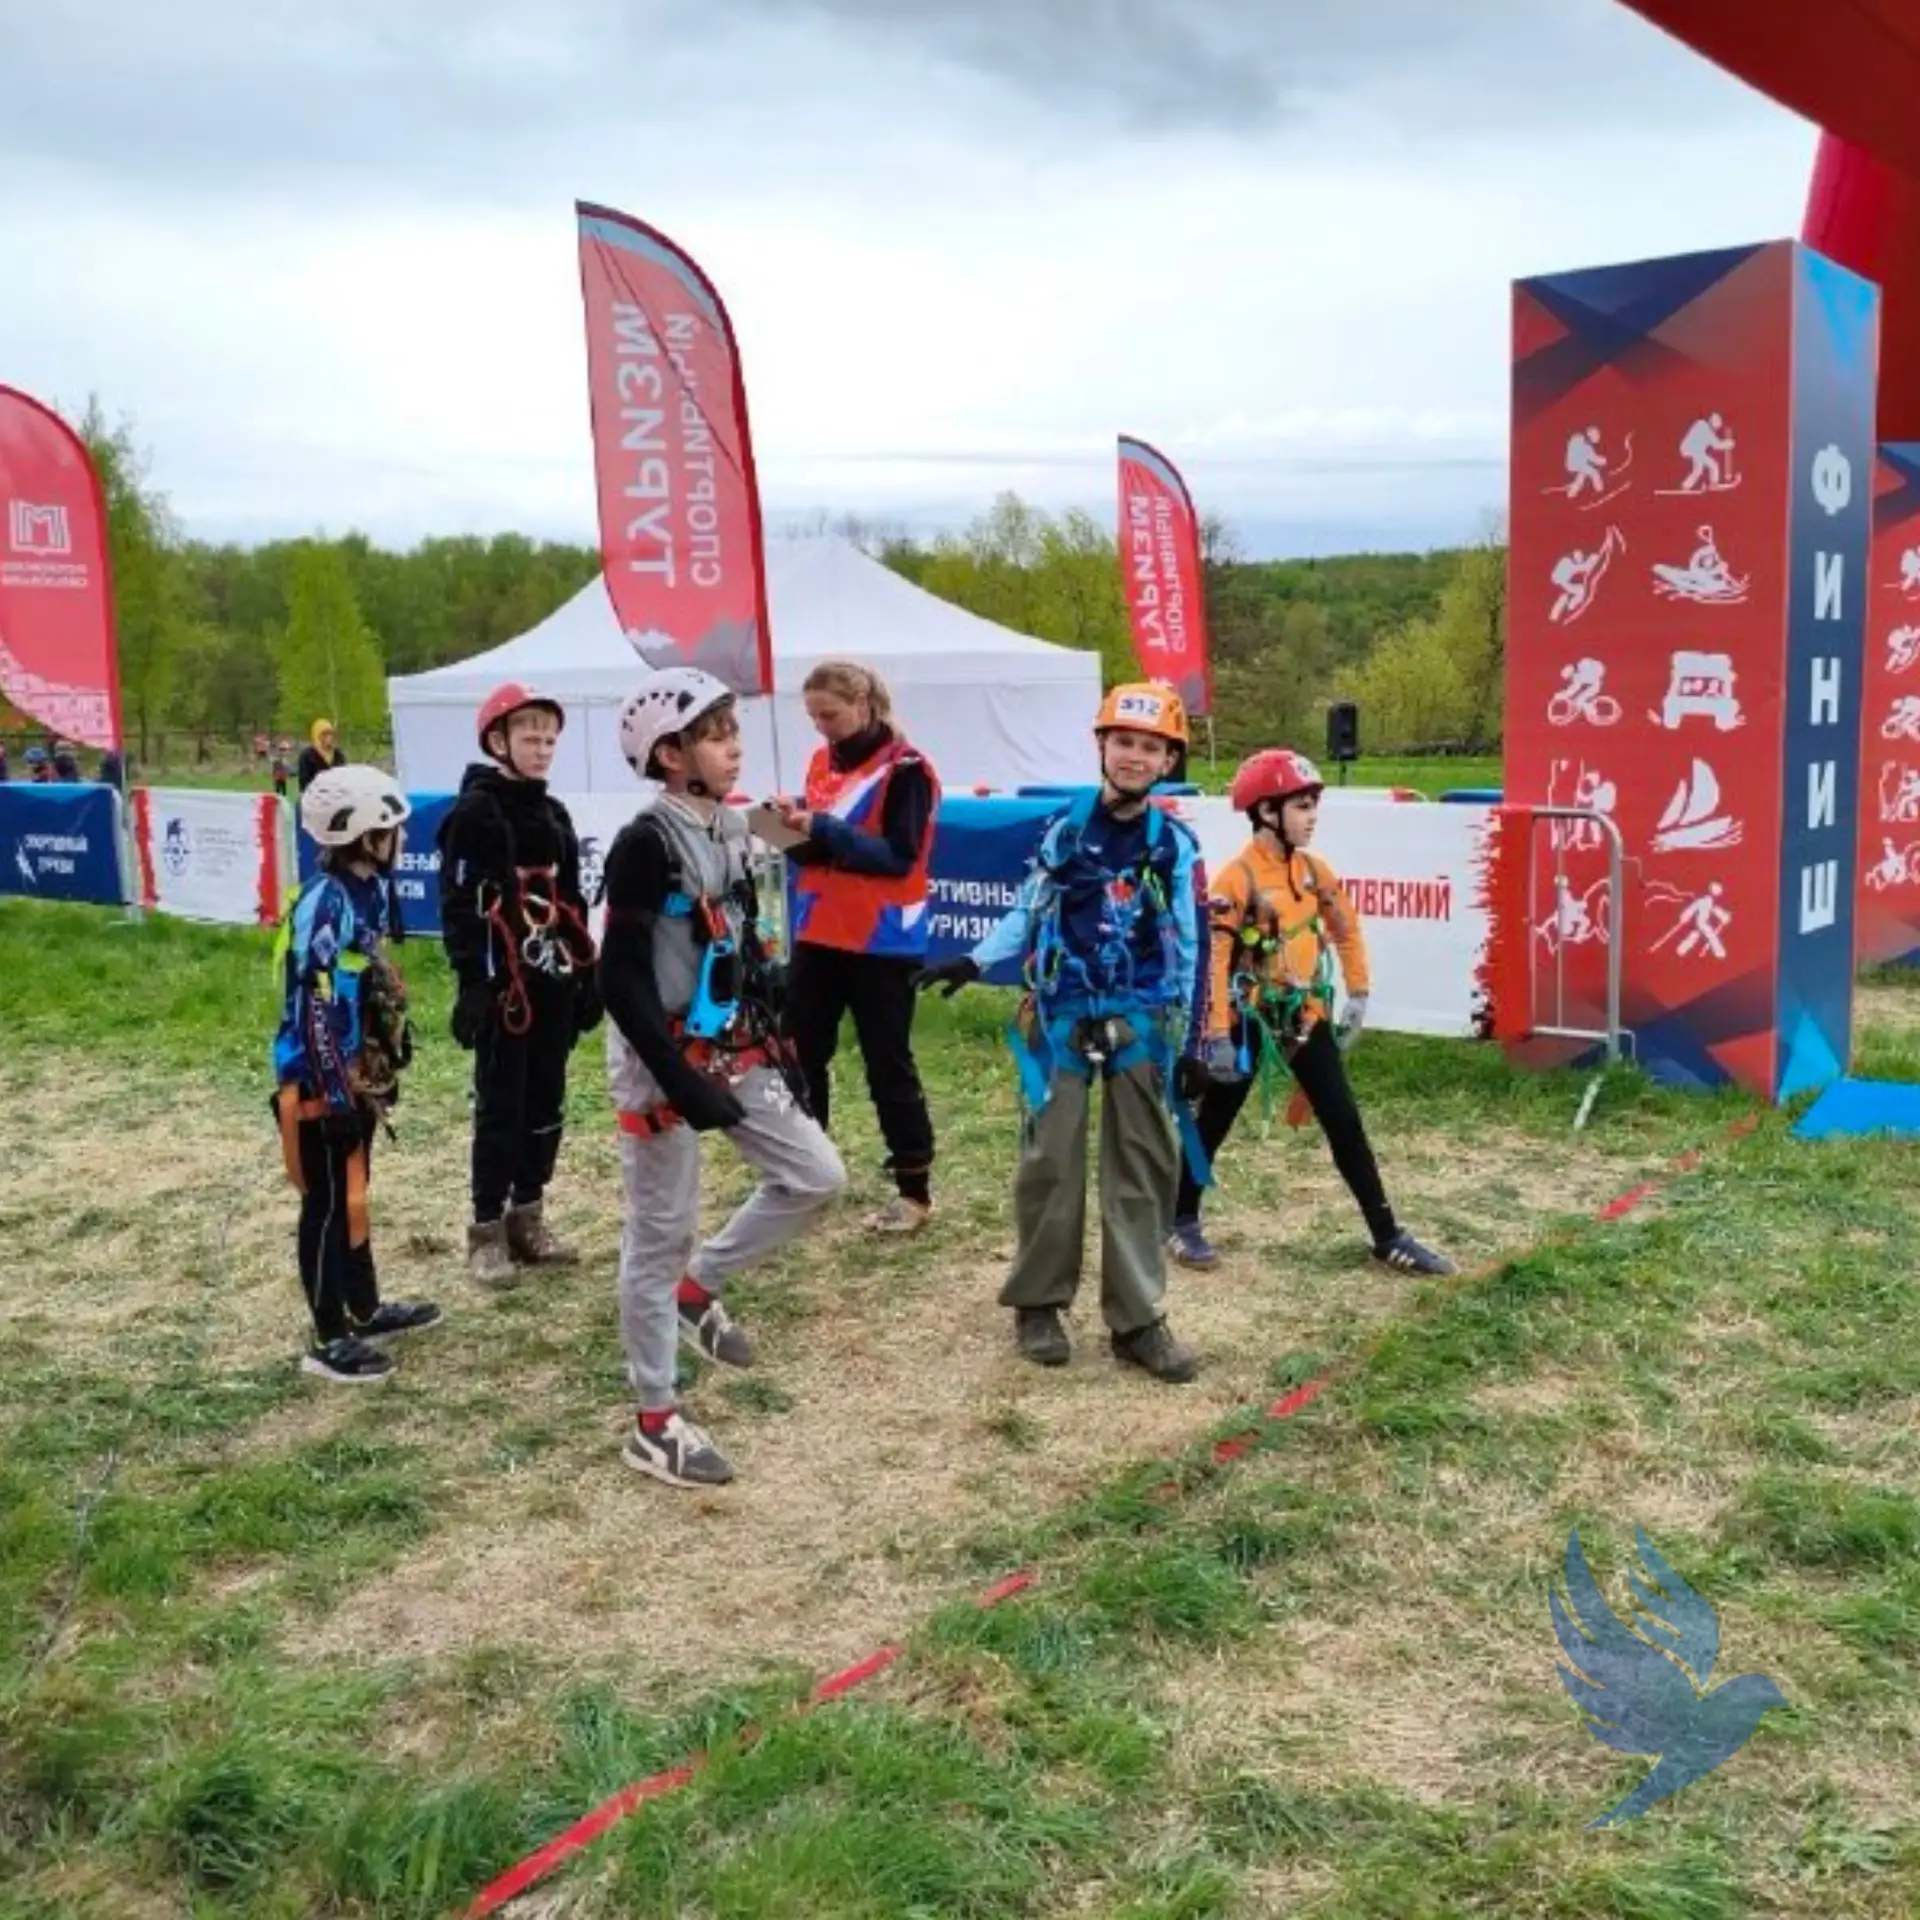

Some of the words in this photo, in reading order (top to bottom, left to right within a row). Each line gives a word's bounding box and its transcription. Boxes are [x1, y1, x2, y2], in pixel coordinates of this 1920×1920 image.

[1800, 443, 1852, 934] ФИНИШ
[927, 878, 1022, 907] РТИВНЫ
[1338, 875, 1451, 922] ОВСКИЙ
[927, 913, 1001, 939] УРИЗМ
